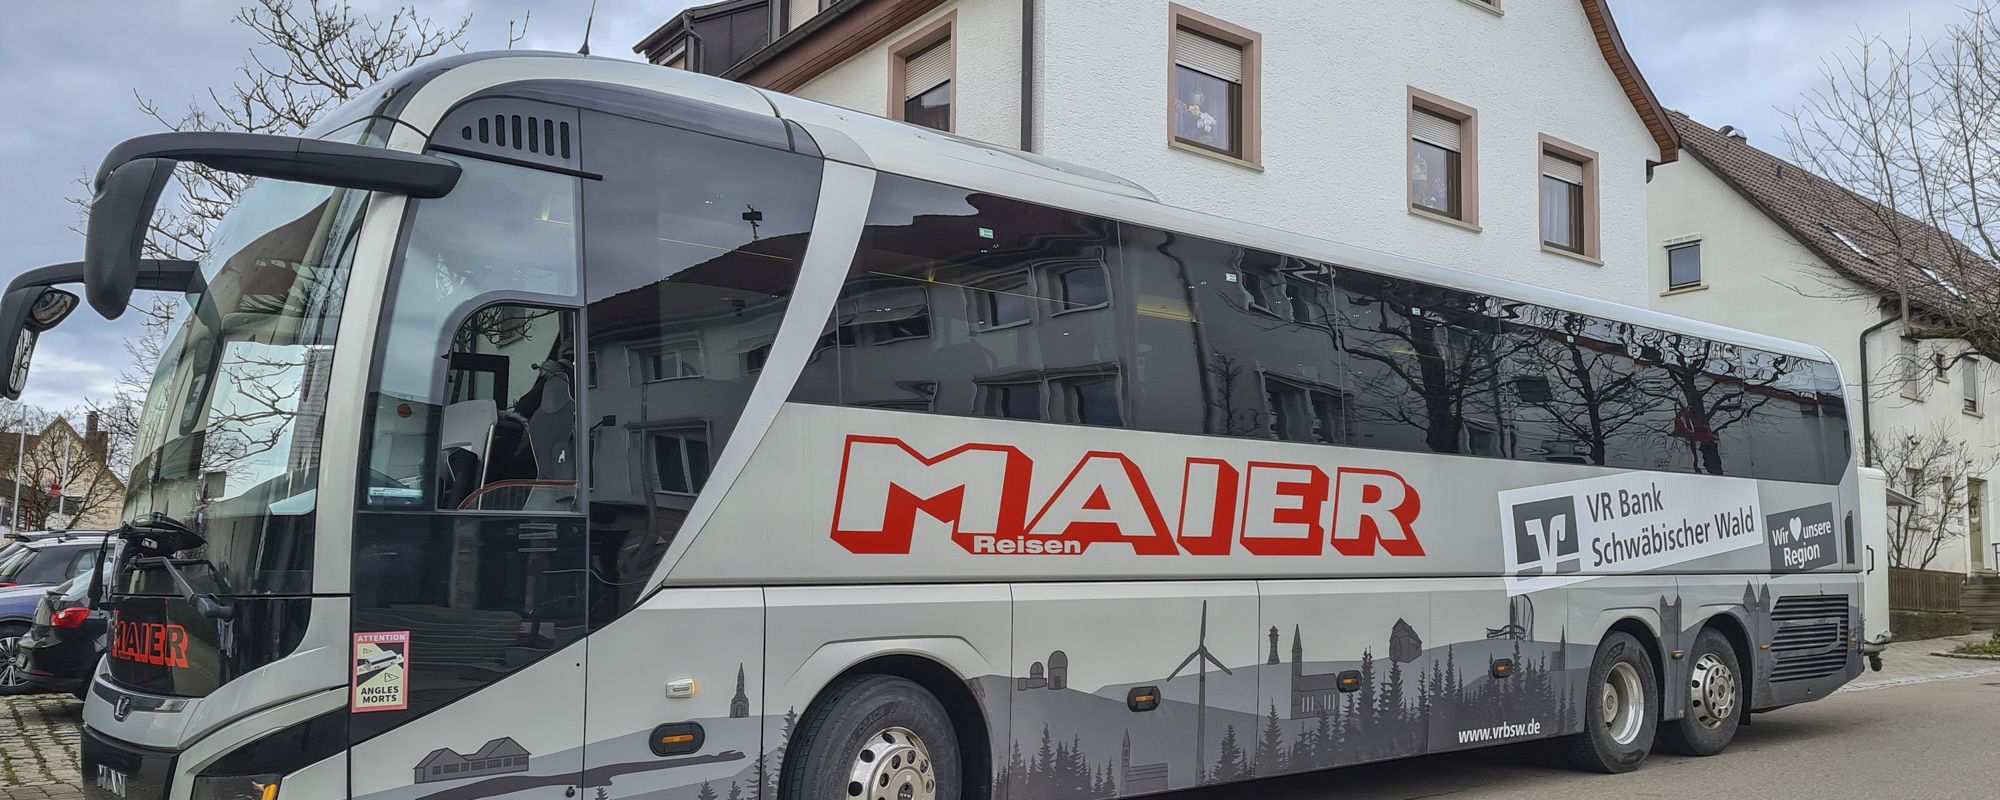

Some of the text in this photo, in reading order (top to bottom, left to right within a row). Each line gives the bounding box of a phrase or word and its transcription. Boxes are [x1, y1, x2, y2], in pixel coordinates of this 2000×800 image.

[830, 434, 1426, 556] MAIER
[1586, 481, 1664, 523] VR Bank
[973, 535, 1081, 554] Reisen
[1592, 505, 1755, 567] Schwäbischer Wald
[1772, 521, 1832, 547] Wir unsere
[1783, 541, 1821, 569] Region
[357, 634, 406, 642] ATTENTION
[361, 686, 399, 695] ANGLES
[362, 694, 397, 704] MORTS
[1458, 718, 1541, 743] www.vrbsw.de
